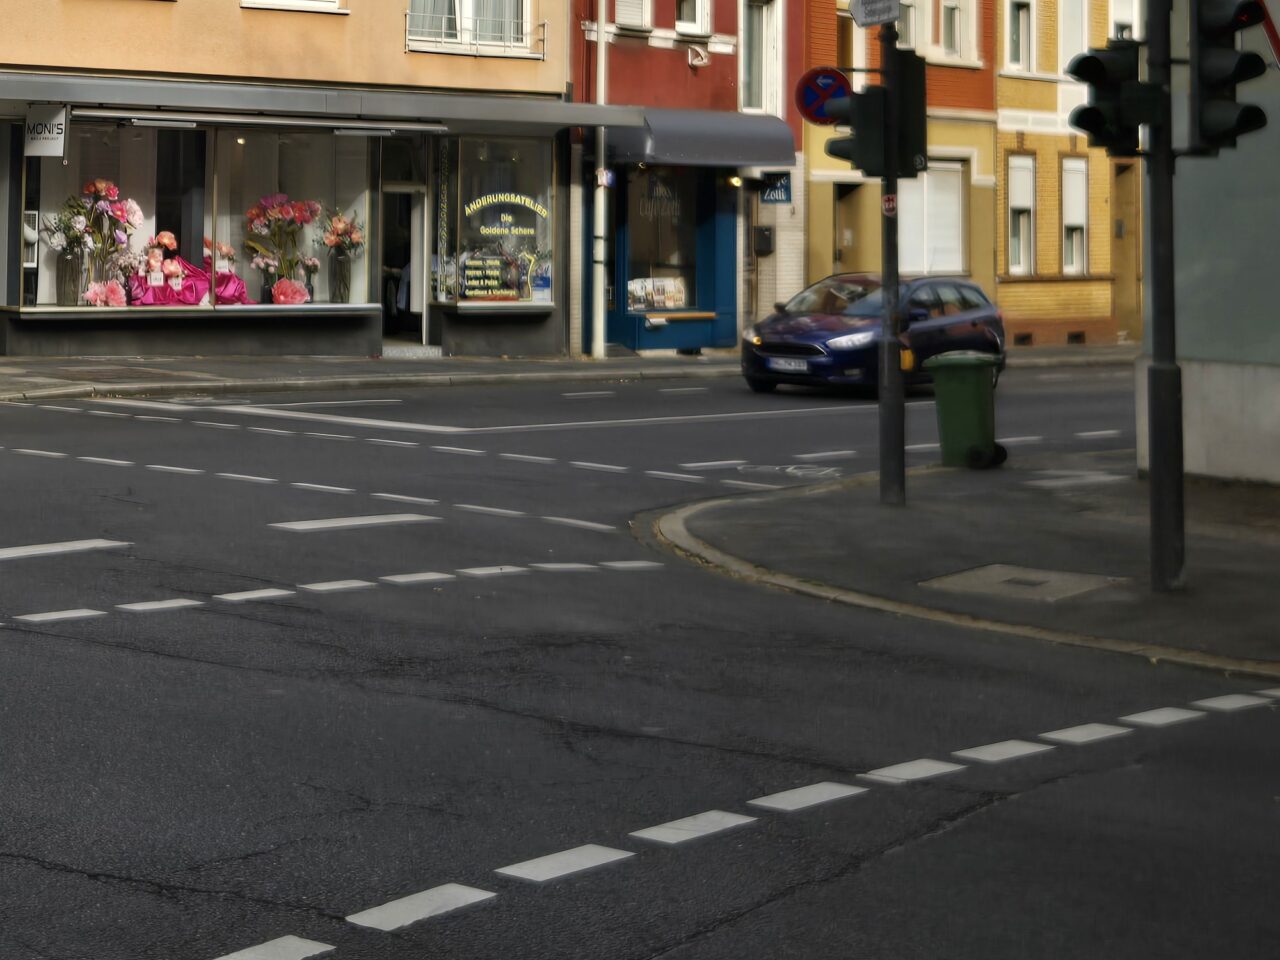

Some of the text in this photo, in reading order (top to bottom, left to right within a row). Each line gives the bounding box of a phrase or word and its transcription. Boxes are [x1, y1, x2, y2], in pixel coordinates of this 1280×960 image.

[27, 123, 63, 135] MONI'S
[501, 213, 512, 222] Die
[480, 225, 535, 235] Goldene Schere
